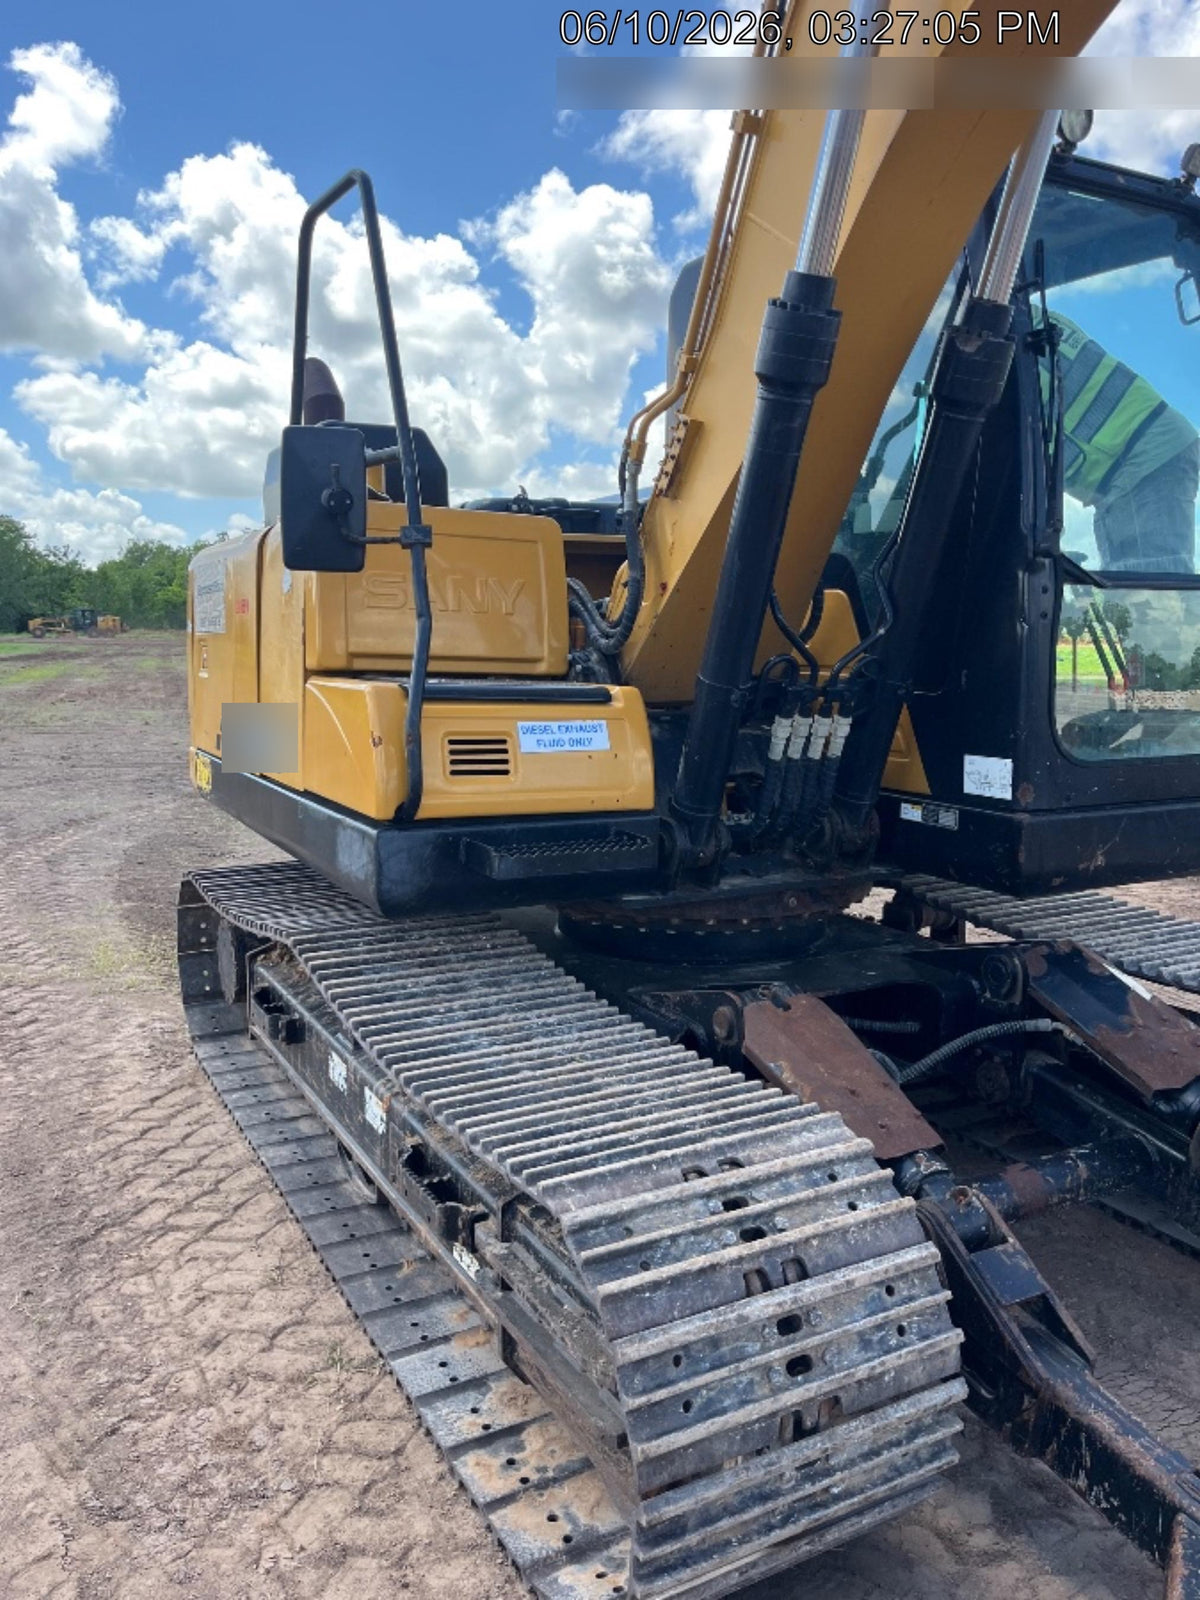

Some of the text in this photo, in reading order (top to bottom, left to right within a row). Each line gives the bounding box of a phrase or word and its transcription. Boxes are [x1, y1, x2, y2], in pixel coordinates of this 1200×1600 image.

[520, 723, 604, 735] DIESEL EXHAUST
[536, 737, 593, 748] FLUID ONLY
